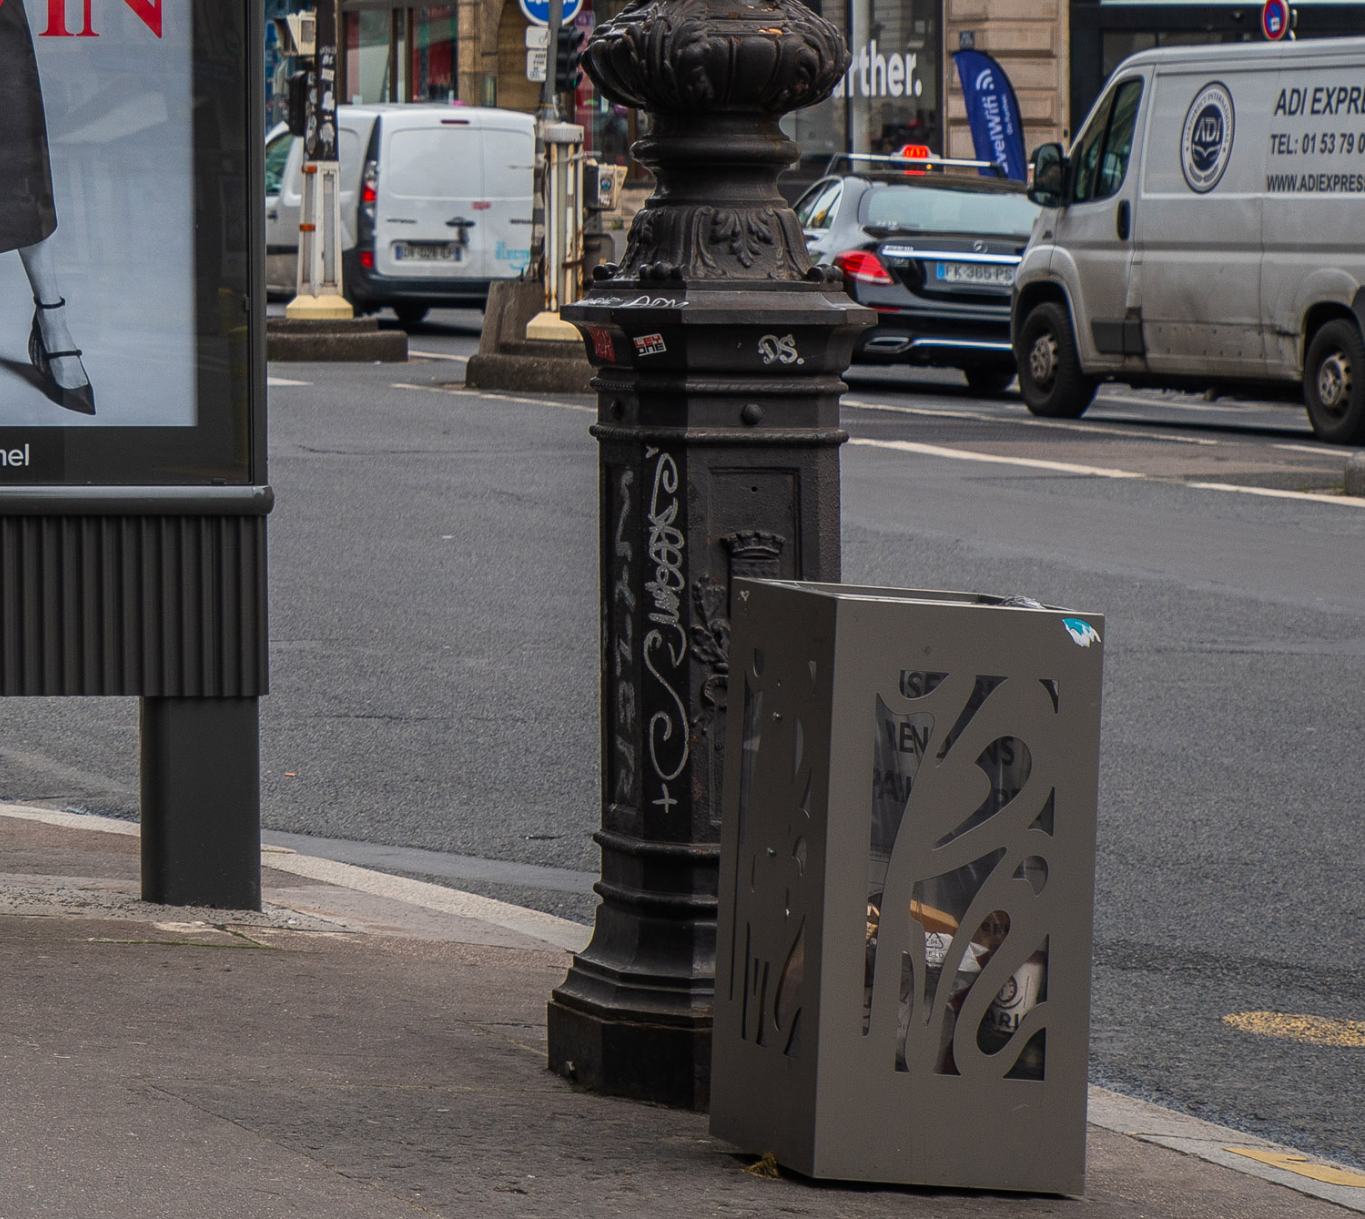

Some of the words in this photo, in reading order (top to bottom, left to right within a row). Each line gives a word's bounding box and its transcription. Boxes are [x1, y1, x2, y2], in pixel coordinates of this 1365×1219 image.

[1274, 87, 1308, 116] ADI
[1195, 117, 1222, 142] ADI
[1270, 133, 1298, 155] TEL:
[1302, 132, 1317, 155] 01
[1320, 132, 1336, 154] 53
[1339, 132, 1355, 154] 79
